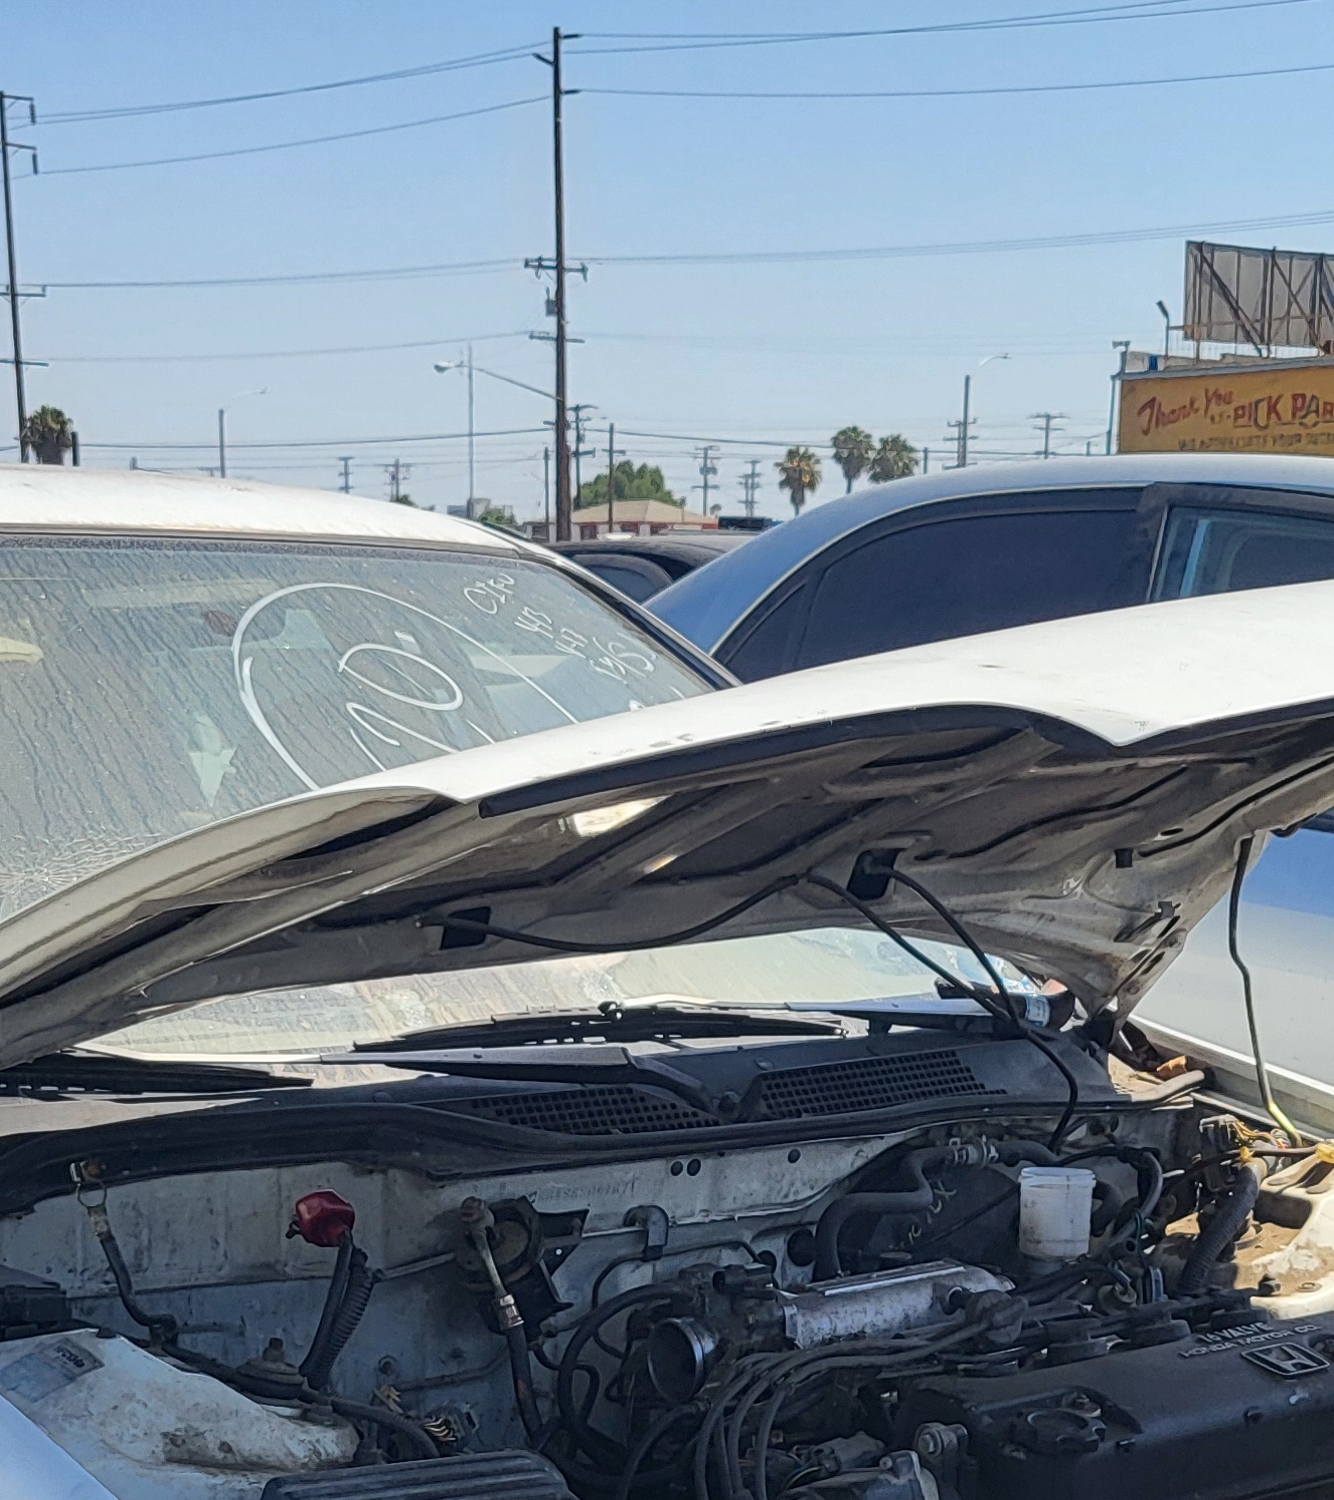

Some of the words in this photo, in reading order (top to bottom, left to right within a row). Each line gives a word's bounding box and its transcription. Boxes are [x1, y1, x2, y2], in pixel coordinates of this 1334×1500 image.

[1217, 1321, 1274, 1340] VALVE
[1178, 1341, 1238, 1359] HONDA
[1237, 1329, 1294, 1346] MOTOR
